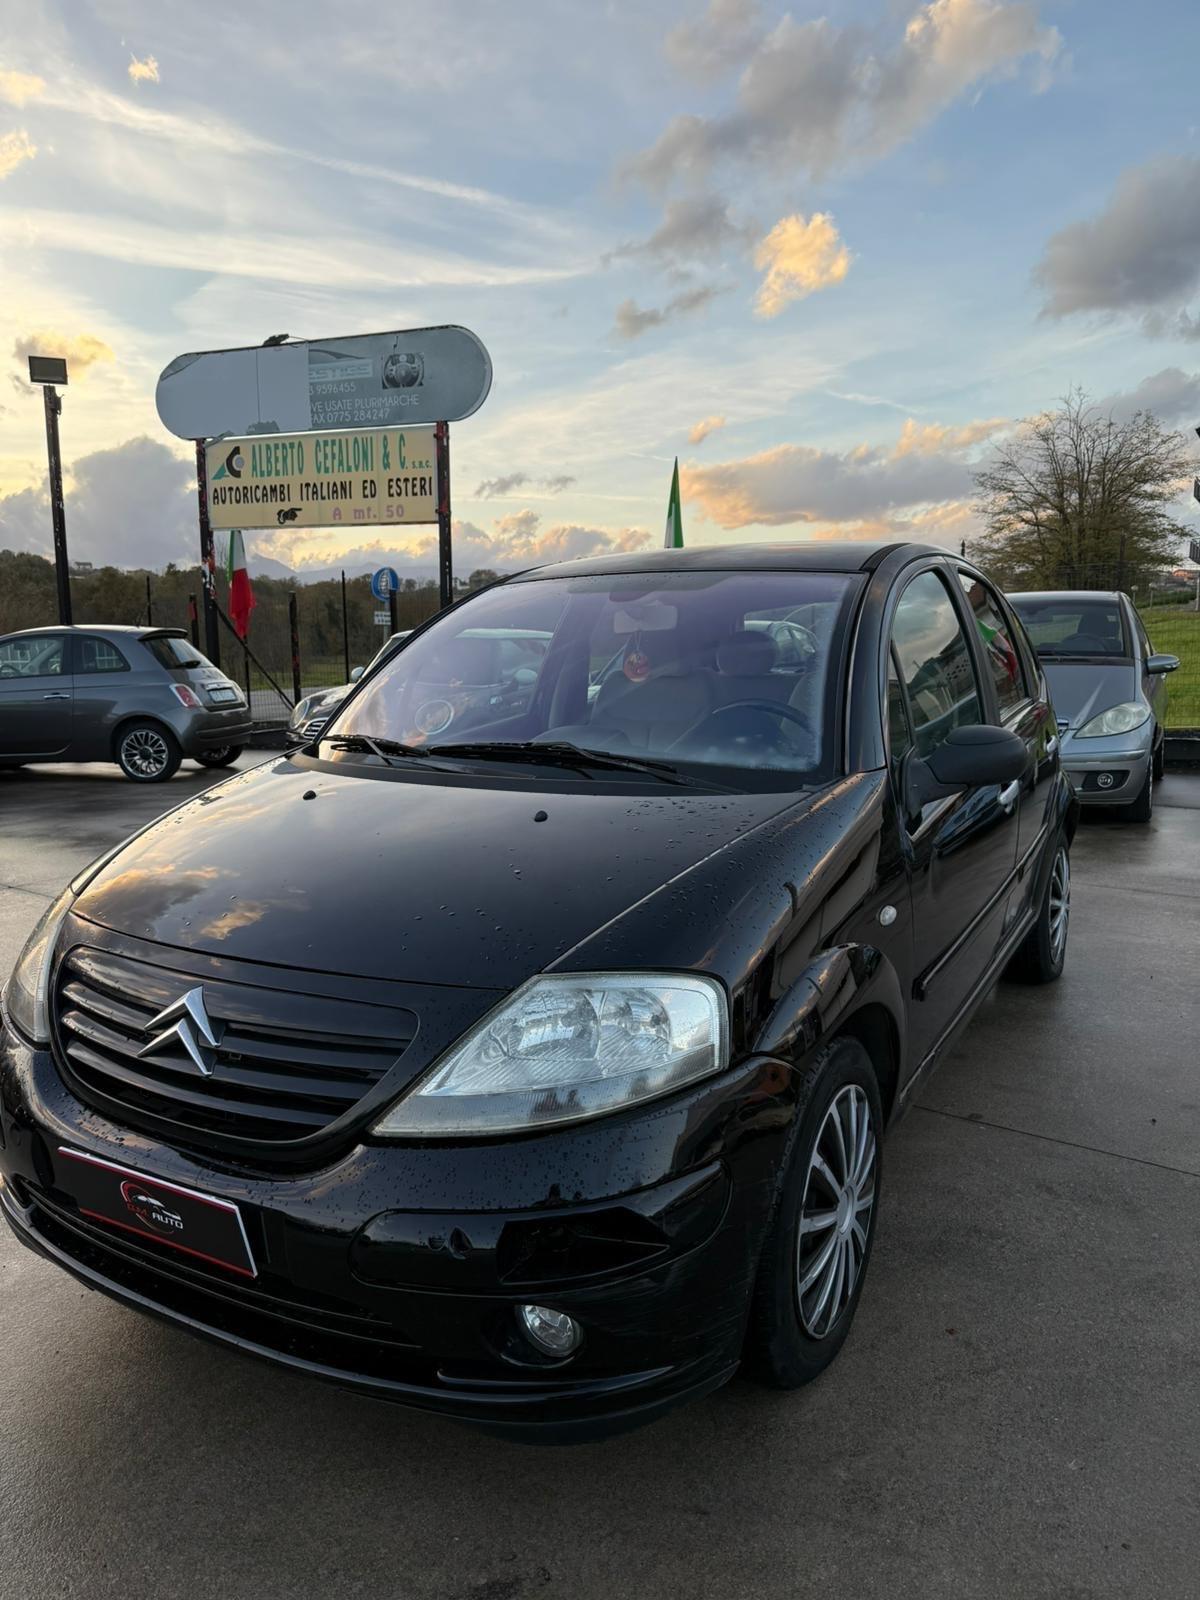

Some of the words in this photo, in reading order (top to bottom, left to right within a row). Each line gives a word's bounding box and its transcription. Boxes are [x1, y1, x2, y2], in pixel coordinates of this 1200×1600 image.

[324, 399, 353, 411] USATE
[355, 394, 420, 408] PLURIMARCHE
[311, 412, 325, 424] AX
[327, 411, 351, 422] 0775
[354, 408, 390, 421] 284247
[251, 440, 304, 478] ALBERTO
[315, 436, 374, 474] CEFALONI
[382, 434, 391, 471] &
[212, 483, 291, 505] AUTORICAMBI
[300, 480, 352, 501] ITALIANI
[362, 479, 377, 498] ED
[387, 476, 433, 497] ESTERI
[332, 507, 342, 520] A
[386, 504, 404, 518] 50
[152, 1212, 184, 1229] AUTO
